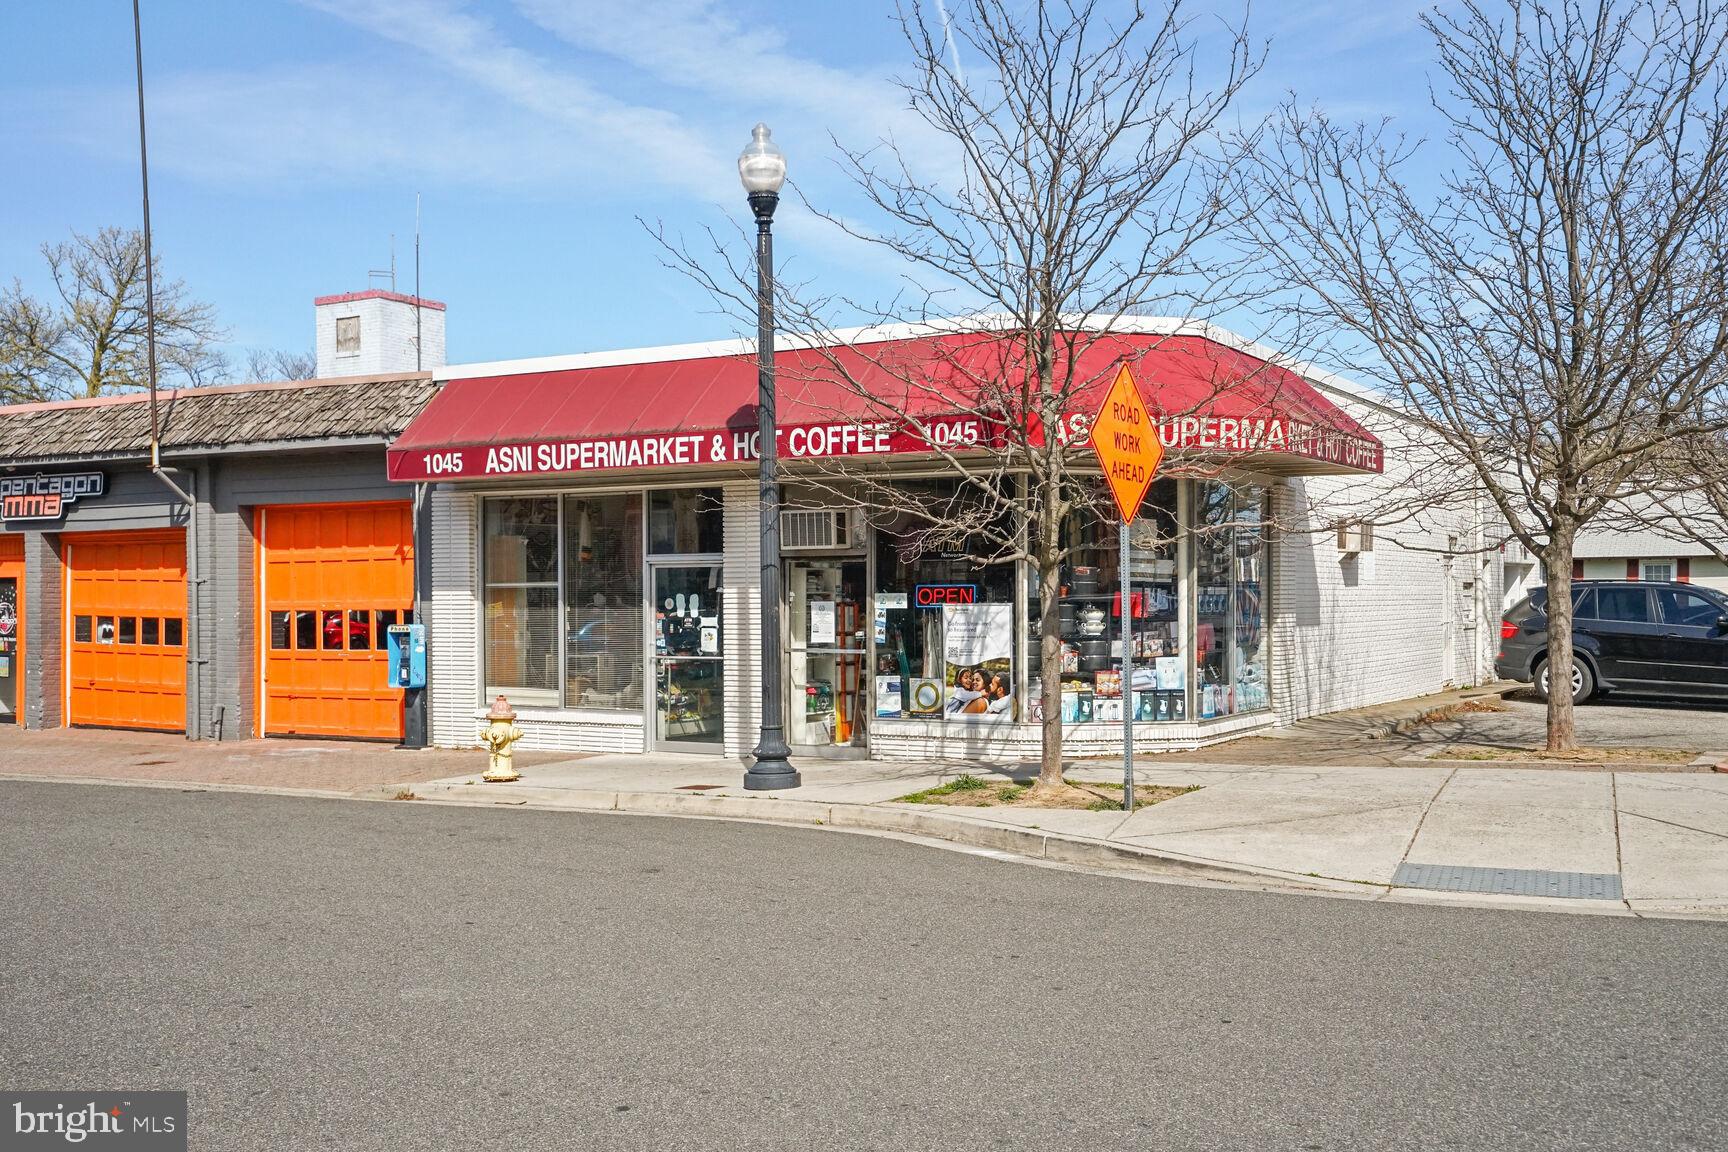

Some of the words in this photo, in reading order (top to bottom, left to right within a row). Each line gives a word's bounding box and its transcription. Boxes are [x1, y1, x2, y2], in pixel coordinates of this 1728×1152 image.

[1113, 402, 1140, 425] ROAD
[423, 452, 463, 473] 1045
[485, 445, 533, 473] ASNI
[537, 436, 704, 471] SUPERMARKET
[710, 434, 726, 462] &
[789, 423, 891, 456] COFFEE
[924, 421, 978, 446] 1045
[1114, 431, 1141, 455] WORK
[1112, 460, 1145, 484] AHEAD
[0, 475, 101, 500] pentagon
[4, 495, 61, 517] mma
[918, 588, 973, 604] OPEN
